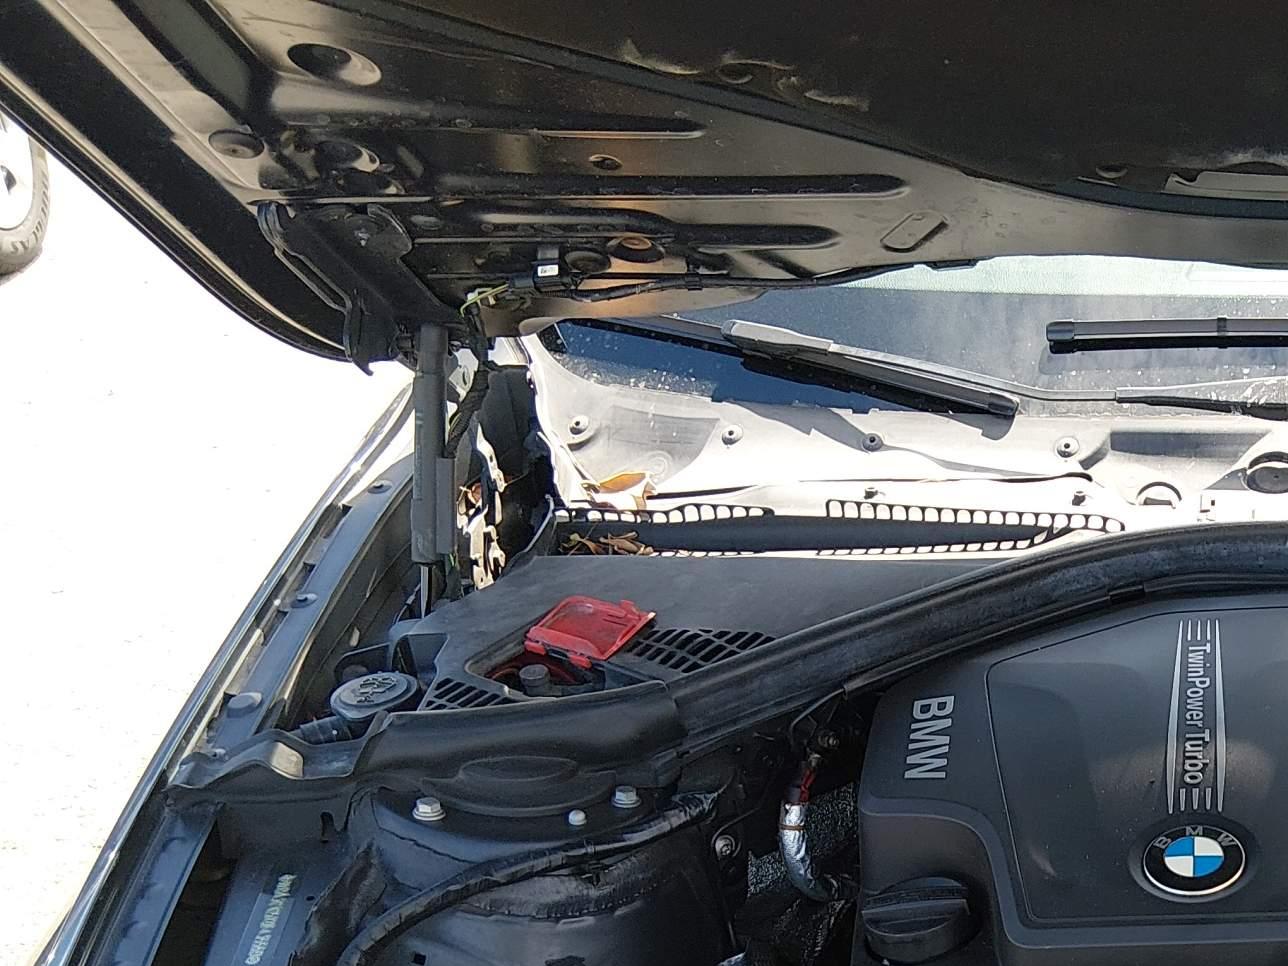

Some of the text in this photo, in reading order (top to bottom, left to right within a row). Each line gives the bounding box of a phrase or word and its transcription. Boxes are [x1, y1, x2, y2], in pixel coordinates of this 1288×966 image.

[904, 695, 955, 779] BMW
[1183, 642, 1211, 785] TwinPower Turbo
[1153, 825, 1237, 849] BMW
